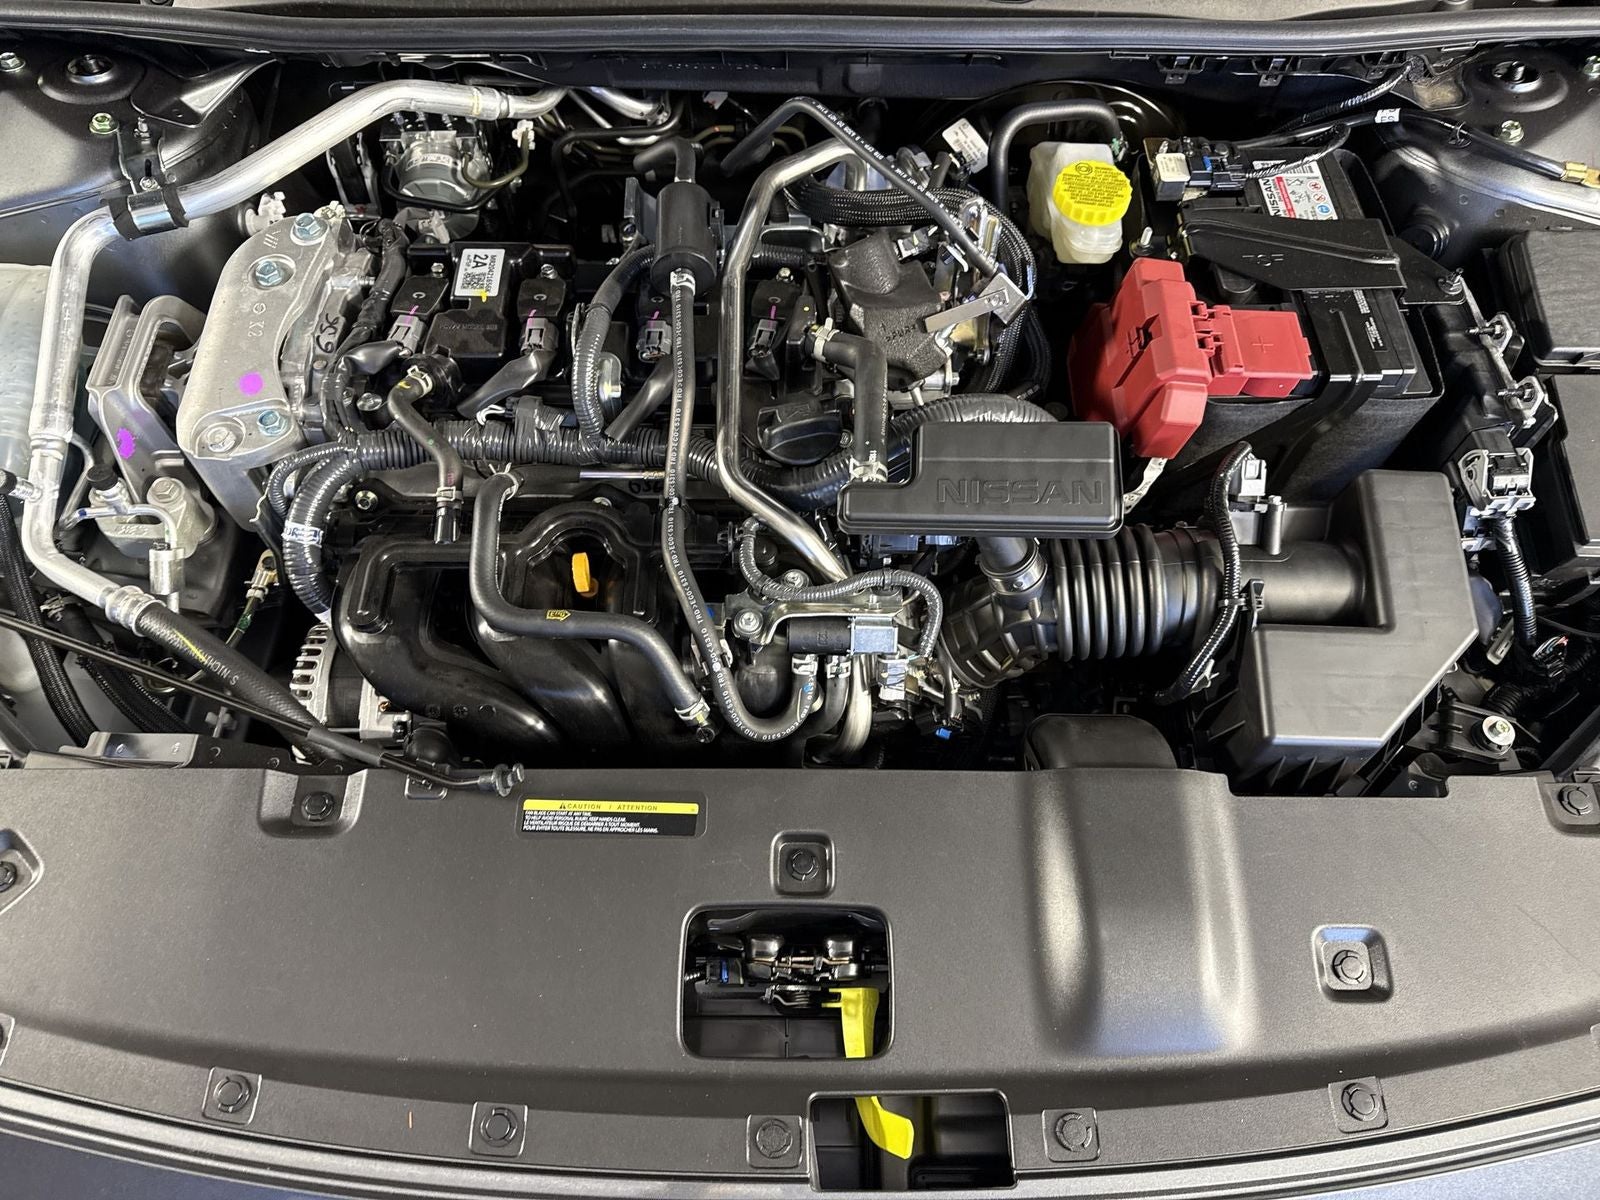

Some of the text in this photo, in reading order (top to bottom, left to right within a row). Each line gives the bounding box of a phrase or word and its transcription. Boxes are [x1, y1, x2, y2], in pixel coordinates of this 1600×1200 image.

[1261, 178, 1281, 217] NISSAN
[472, 254, 488, 269] 2A
[938, 478, 1104, 504] NISSAN
